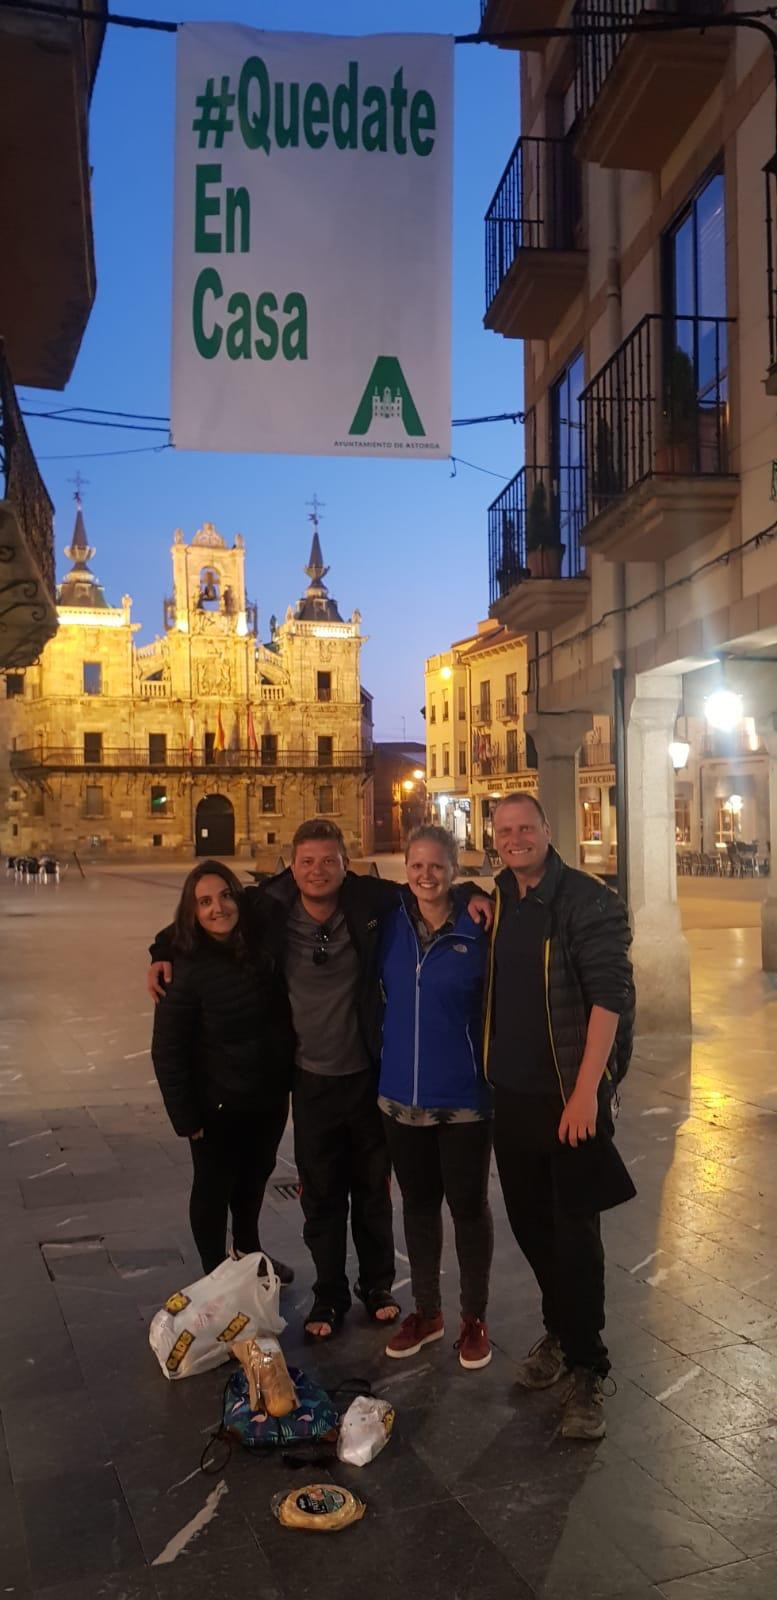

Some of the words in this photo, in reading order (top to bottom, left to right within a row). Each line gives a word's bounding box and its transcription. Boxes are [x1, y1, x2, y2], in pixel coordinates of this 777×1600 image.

[192, 56, 436, 157] #Quedate
[194, 163, 250, 253] En
[192, 267, 308, 361] Casa
[334, 440, 393, 449] AYUNTAMIENTO
[394, 441, 404, 449] DE
[405, 442, 440, 450] ASTORGA
